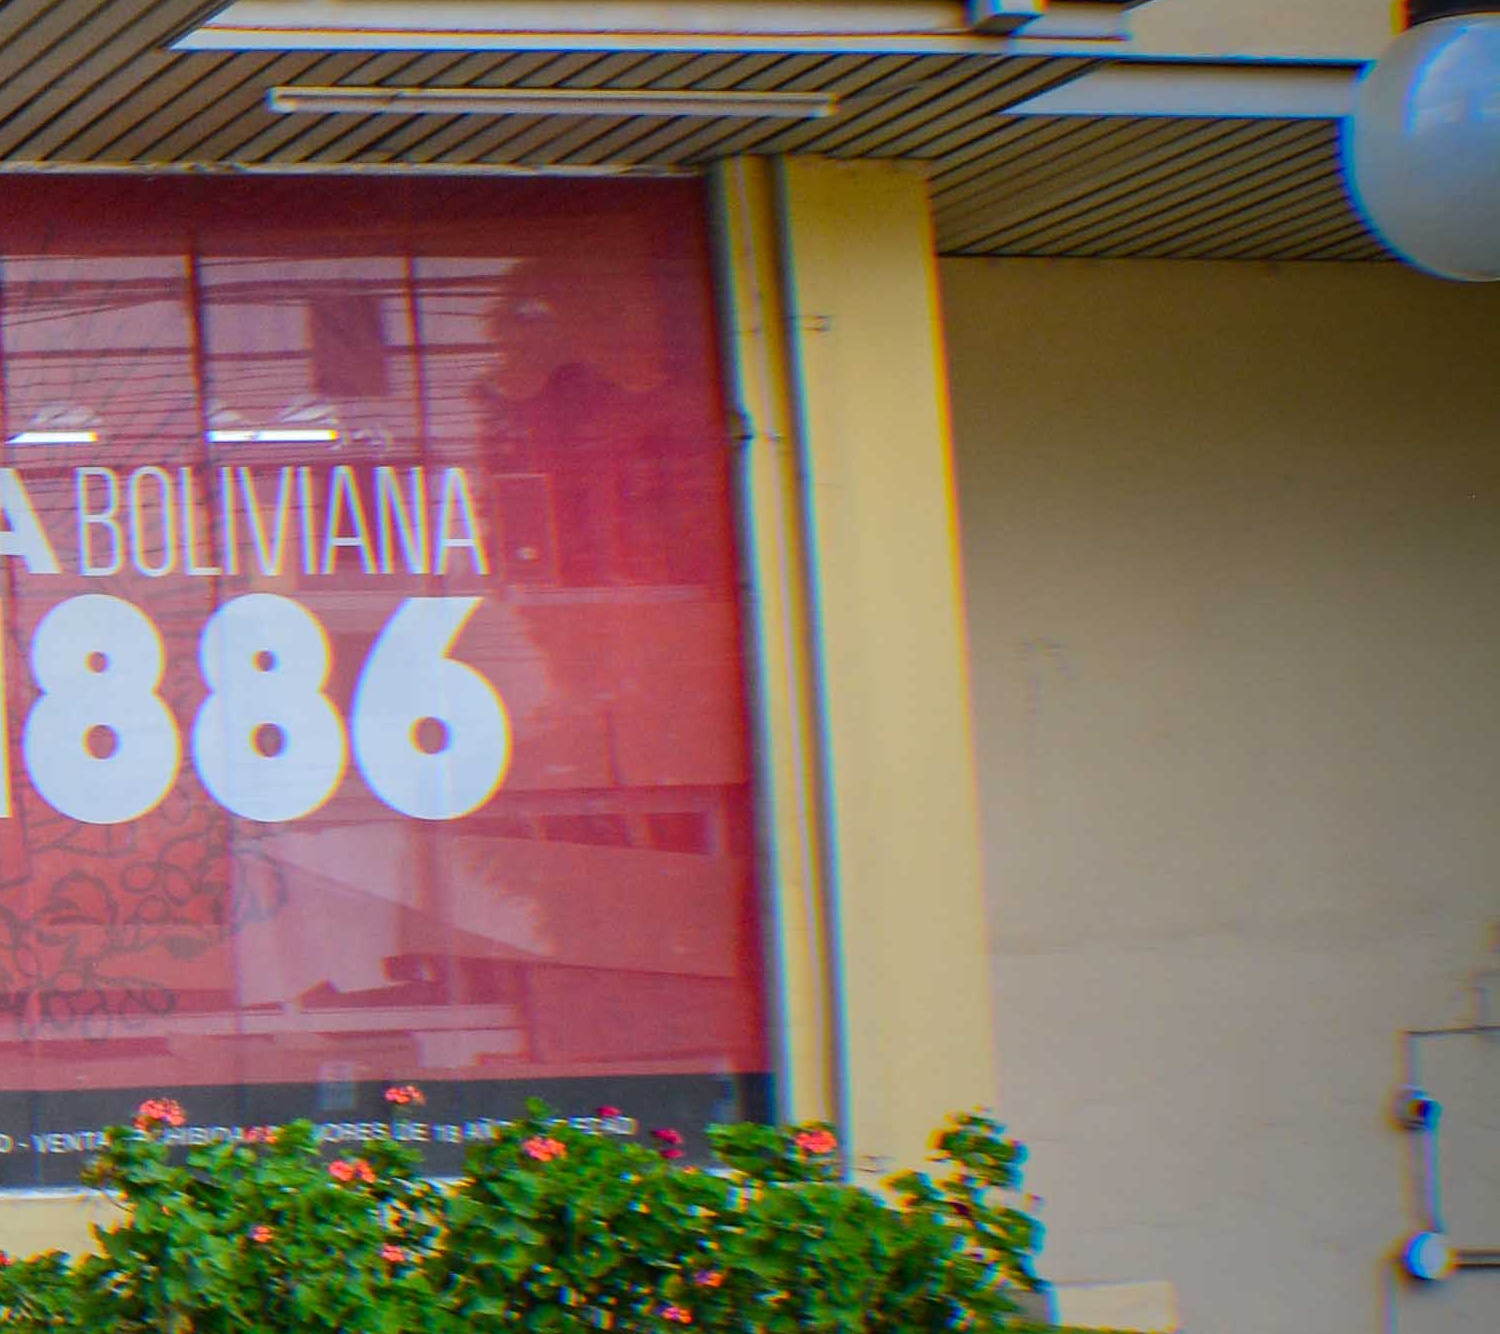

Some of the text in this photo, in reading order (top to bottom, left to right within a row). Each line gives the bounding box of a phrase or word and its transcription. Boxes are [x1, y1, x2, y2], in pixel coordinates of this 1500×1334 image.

[74, 465, 491, 576] BOLIVIANA
[31, 1131, 111, 1154] VENTA
[392, 1122, 429, 1142] DE
